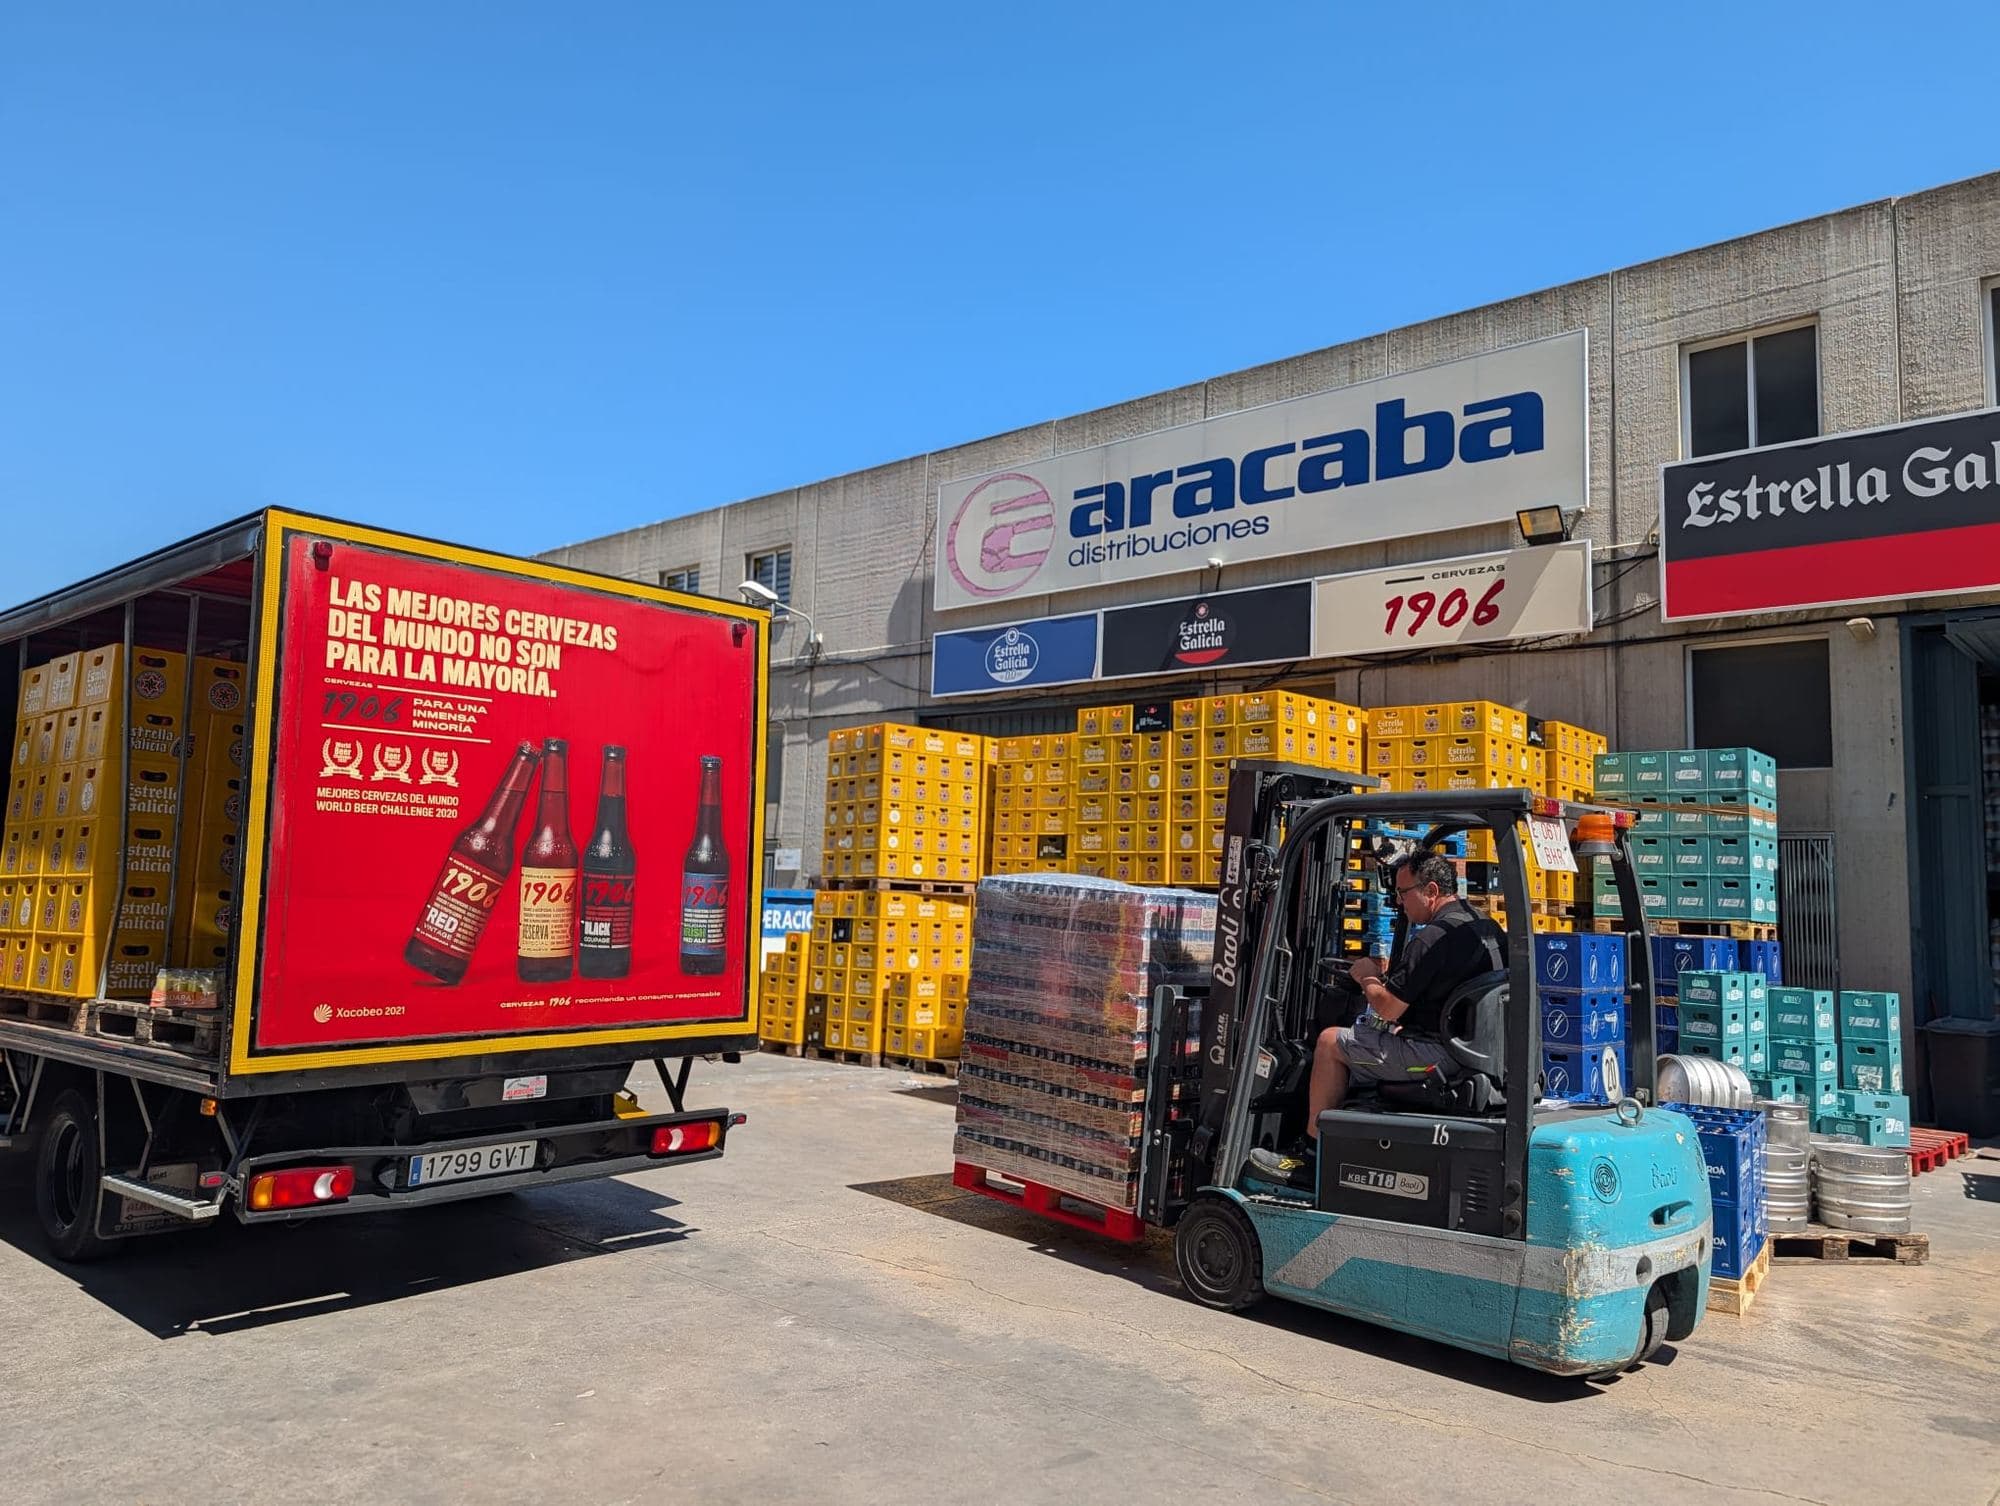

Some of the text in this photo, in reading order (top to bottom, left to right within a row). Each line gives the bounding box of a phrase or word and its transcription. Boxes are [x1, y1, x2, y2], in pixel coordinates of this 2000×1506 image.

[1068, 391, 1545, 538] aracaba
[1682, 461, 1891, 529] Estrella
[1068, 515, 1271, 567] distribuciones
[1432, 565, 1505, 580] CERVEZAS
[330, 577, 618, 651] LAS MEJORES CERVEZAS
[1385, 579, 1505, 637] 1906
[1178, 618, 1226, 636] Estrella
[328, 608, 560, 670] DEL MUNDO NO SON
[1180, 633, 1223, 650] Galicia
[994, 643, 1030, 658] Estrella
[326, 640, 557, 698] PARA LA MAYORÍA.
[995, 656, 1028, 670] Galicia
[324, 677, 373, 688] CERVEZAS
[323, 691, 404, 723] 1906
[413, 698, 488, 714] PARA UNA
[413, 709, 477, 723] INMENSA
[412, 720, 473, 733] MINORÍA
[317, 787, 459, 806] MEJORES CERVEZAS DEL MUNDO
[316, 801, 458, 819] WORLD BEER CHALLENGE 2020
[443, 868, 501, 908] 1906
[524, 878, 576, 907] 1906
[586, 879, 634, 905] 1906
[685, 884, 728, 906] 1906
[426, 907, 459, 933] RED
[1213, 914, 1239, 987] Baoli
[500, 1000, 545, 1008] CERVEZAS
[549, 997, 571, 1007] 1906
[575, 996, 624, 1004] recomienda
[638, 993, 674, 1001] consumo
[675, 991, 721, 999] responsable
[336, 1006, 405, 1018] Xacobeo 2021
[1432, 1124, 1449, 1146] 16
[429, 1145, 530, 1179] 1799 GVT
